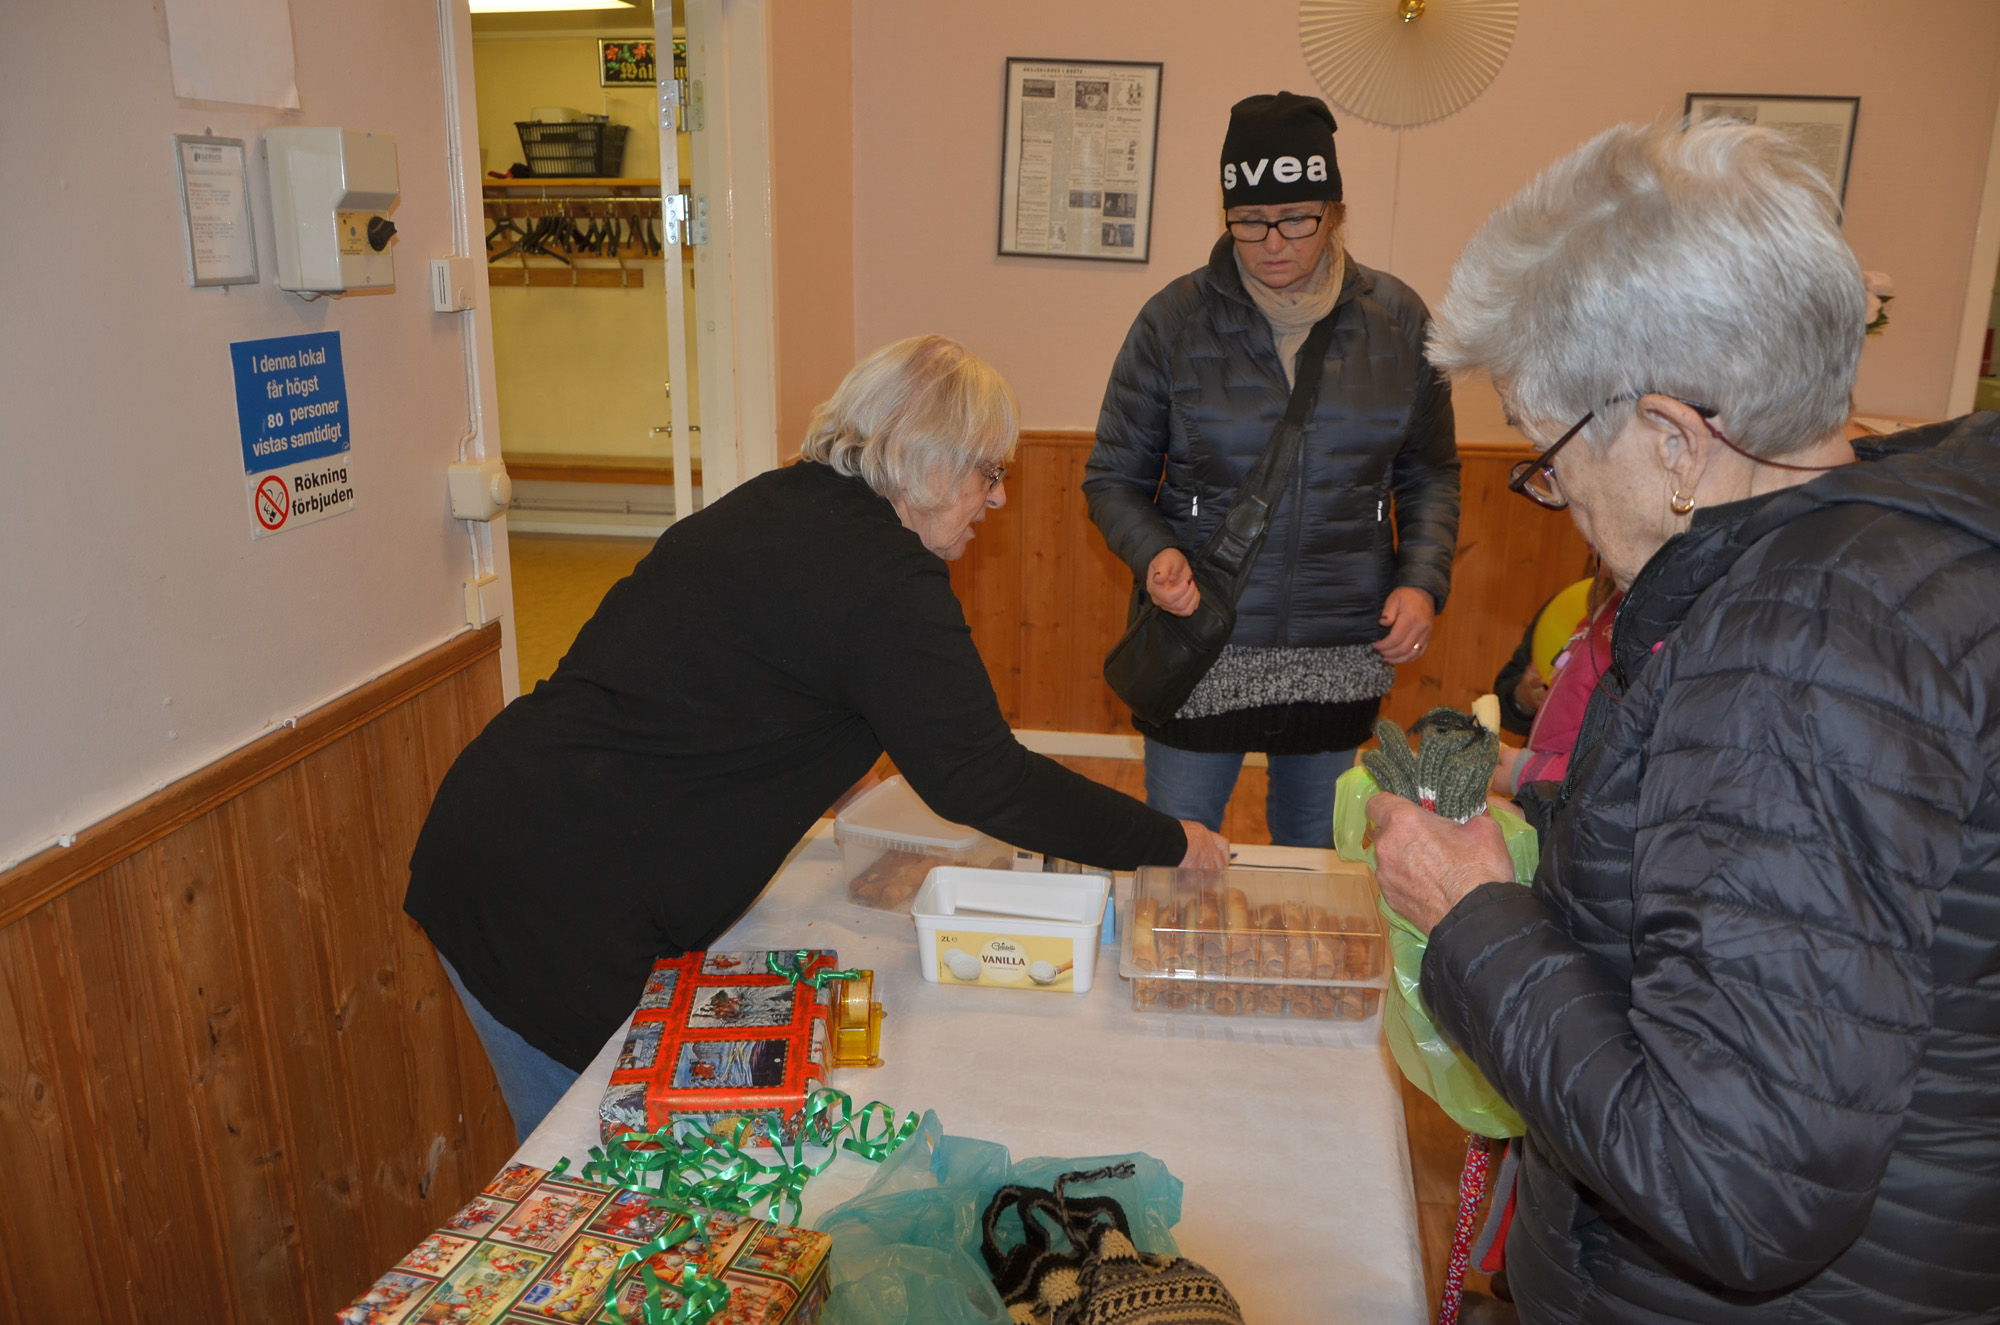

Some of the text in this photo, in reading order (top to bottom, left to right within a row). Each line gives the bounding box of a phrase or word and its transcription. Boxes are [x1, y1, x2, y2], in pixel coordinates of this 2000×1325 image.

[1224, 155, 1328, 190] svea
[252, 347, 326, 374] I denna lokal
[266, 375, 320, 399] får högst
[267, 400, 340, 429] 80 personer
[252, 422, 342, 457] vistas samtidigt
[294, 467, 348, 493] Rökning
[292, 487, 354, 516] förbjuden
[982, 954, 1026, 966] VANILLA
